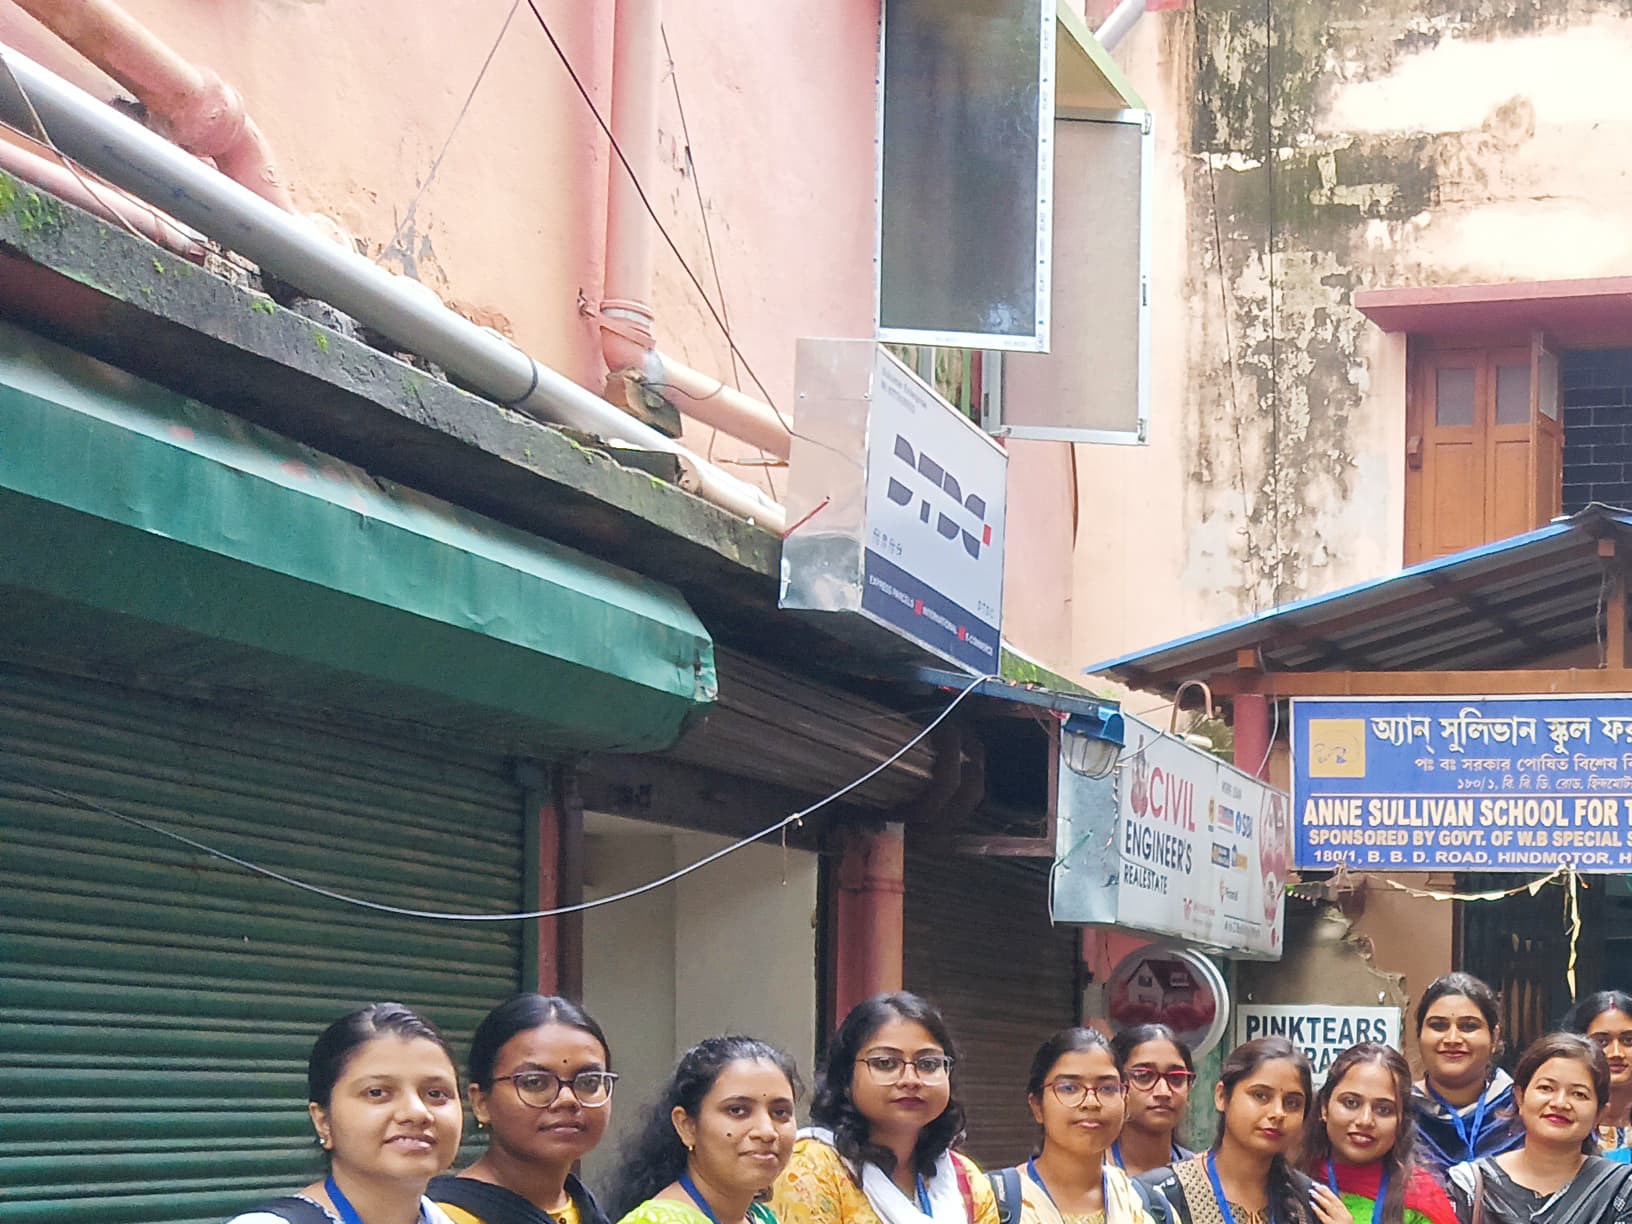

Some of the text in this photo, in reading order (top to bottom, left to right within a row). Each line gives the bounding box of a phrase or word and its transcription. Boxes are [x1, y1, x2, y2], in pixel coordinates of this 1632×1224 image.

[1370, 712, 1435, 754] অ্যান্
[1438, 707, 1538, 753] সুলিভান
[1544, 716, 1592, 755] স্কুল
[1462, 757, 1511, 772] সরকার
[1517, 753, 1569, 772] পোষিত
[1573, 752, 1618, 771] বিশেষ
[1149, 767, 1195, 832] CIVIL
[1303, 798, 1363, 826] ANNE
[1368, 798, 1474, 827] SULLIVAN
[1480, 798, 1569, 827] SCHOOL
[1575, 798, 1618, 826] FOR
[1125, 819, 1193, 875] ENGINEER'S
[1309, 829, 1409, 846] SPONSORED
[1413, 830, 1436, 846] BY
[1439, 830, 1487, 846] GOVT.
[1491, 830, 1513, 846] OF
[1517, 831, 1548, 847] W.B
[1553, 831, 1622, 847] SPECIAL
[1313, 850, 1363, 865] 180/1,
[1367, 850, 1386, 863] B.
[1390, 850, 1408, 863] B.
[1413, 851, 1430, 863] D.
[1435, 850, 1493, 866] ROAD,
[1499, 851, 1614, 866] HINDMOTOR,
[1246, 1015, 1388, 1044] PINKTEARS
